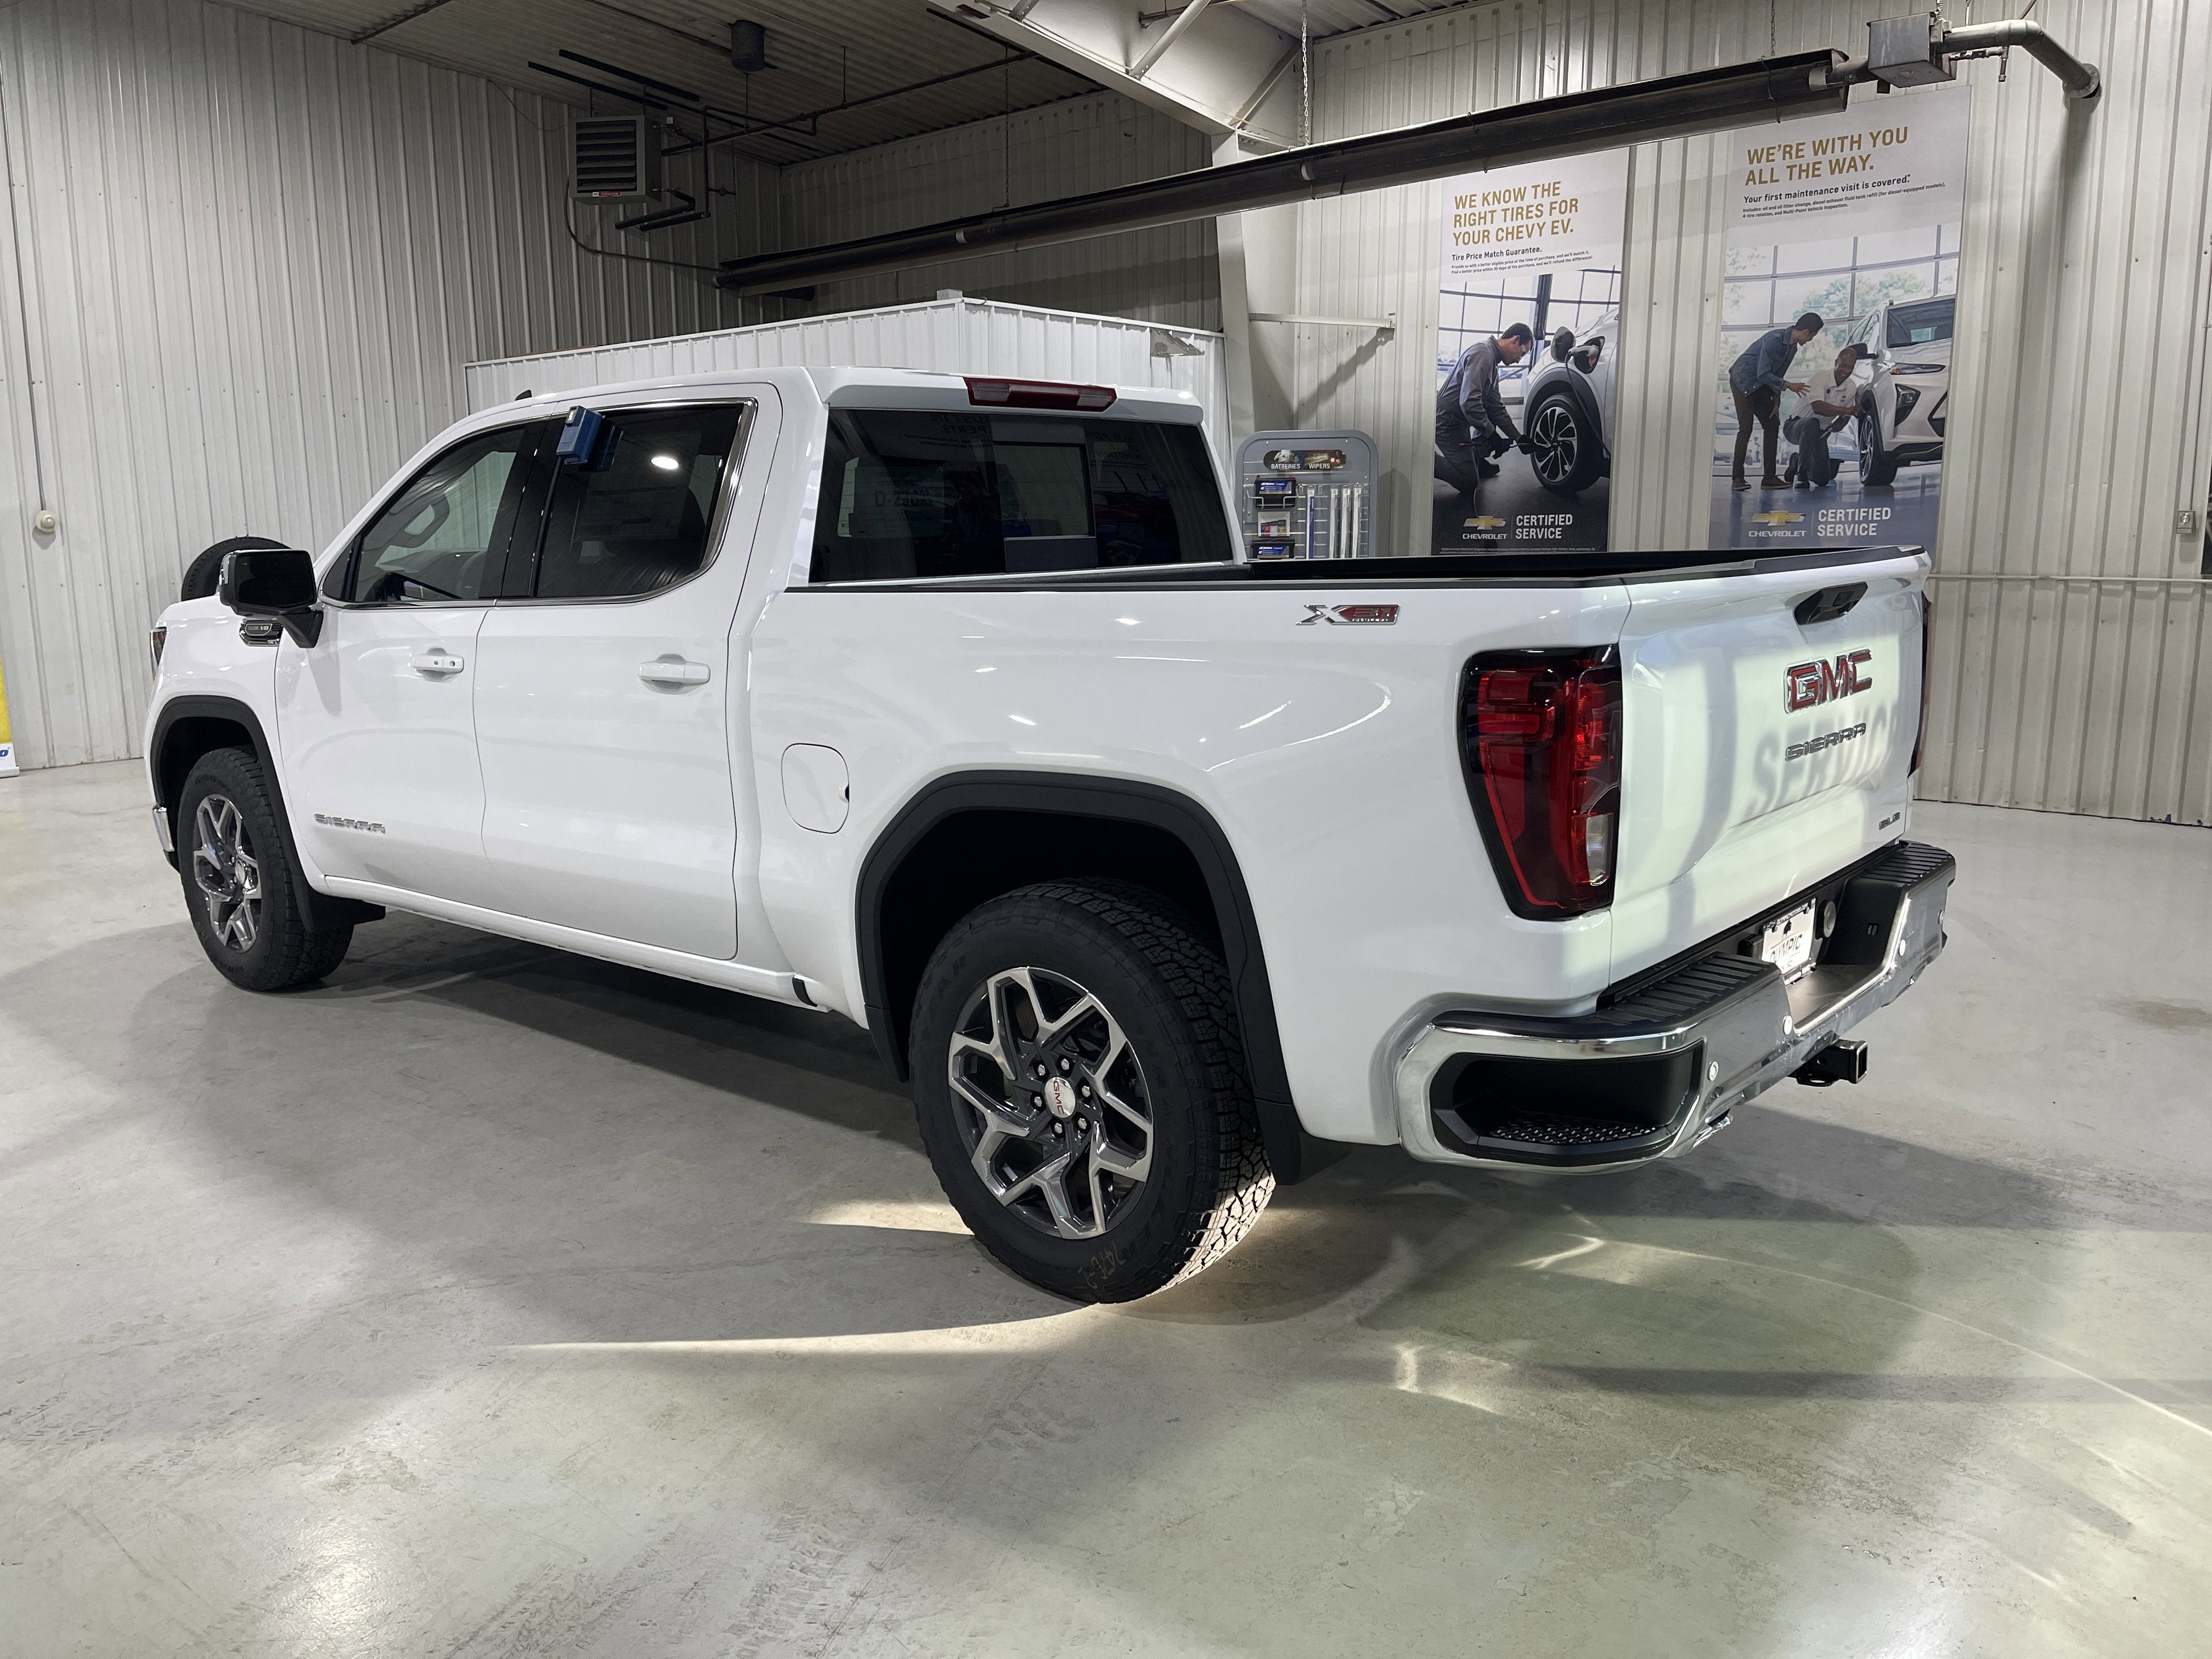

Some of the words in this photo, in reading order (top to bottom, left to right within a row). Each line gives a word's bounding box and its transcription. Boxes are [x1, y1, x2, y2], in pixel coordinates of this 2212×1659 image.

[1747, 142, 1805, 165] WE'RE
[1812, 133, 1862, 157] WITH
[1869, 126, 1908, 148] YOU
[1745, 168, 1780, 187] ALL
[1786, 161, 1822, 181] THE
[1829, 154, 1874, 176] WAY.
[1454, 194, 1477, 210] WE
[1482, 187, 1527, 206] KNOW
[1531, 181, 1561, 199] THE
[1764, 193, 1782, 202] first
[1785, 187, 1839, 200] maintenance
[1841, 183, 1860, 193] visit
[1862, 181, 1869, 189] is
[1454, 210, 1499, 228] RIGHT
[1501, 203, 1543, 222] TIRES
[1549, 198, 1578, 216] FOR
[1453, 229, 1490, 246] YOUR
[1496, 222, 1546, 242] CHEVY
[1550, 218, 1574, 235] EV.
[1484, 250, 1504, 258] Match
[1505, 246, 1542, 256] Guarantee.
[1516, 514, 1573, 526] CERTIFIED
[1818, 507, 1892, 522] CERTIFIED
[1515, 527, 1562, 539] SERVICE
[1817, 523, 1877, 537] SERVICE
[1784, 648, 1872, 713] GMC
[1785, 723, 1866, 761] SIERRA
[314, 814, 386, 834] SIERRA
[1878, 812, 1900, 830] SLE
[1053, 1080, 1064, 1115] GMC
